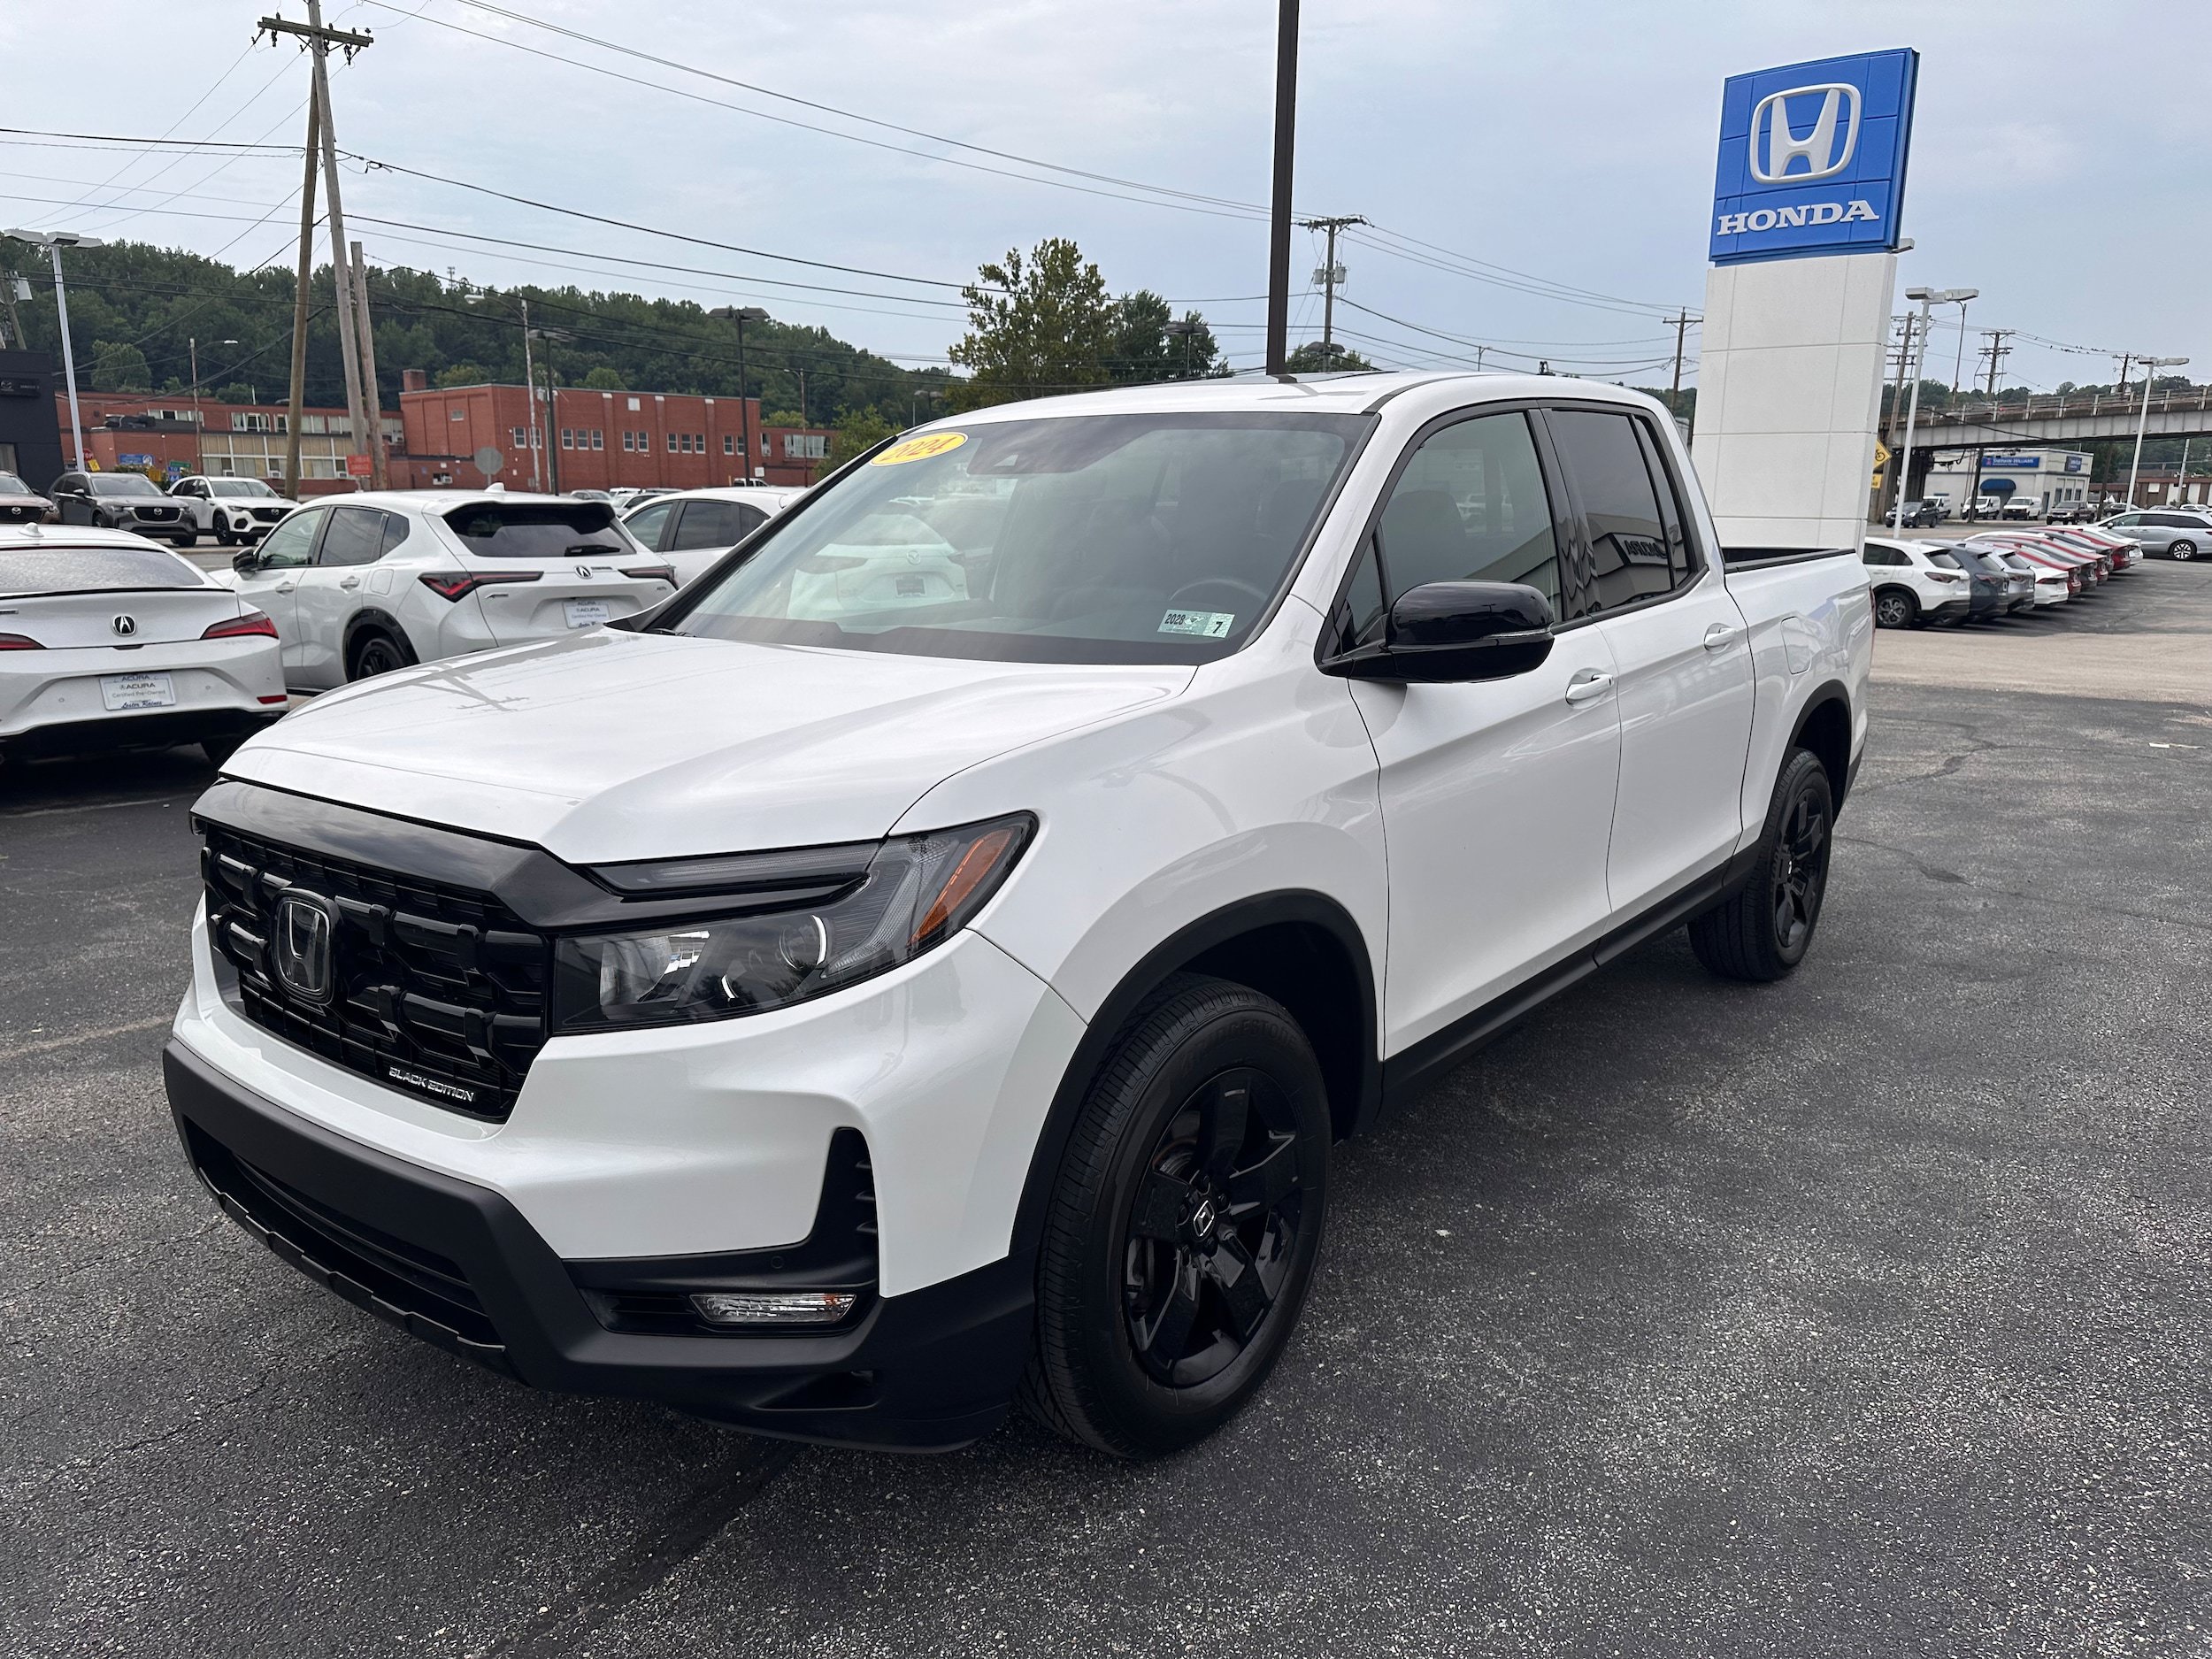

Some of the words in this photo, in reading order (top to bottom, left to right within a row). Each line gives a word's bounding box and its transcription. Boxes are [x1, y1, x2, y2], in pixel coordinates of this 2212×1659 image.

[1717, 199, 1879, 235] HONDA
[879, 436, 958, 462] 2024
[1164, 613, 1186, 626] 2028
[1212, 621, 1224, 634] 7
[389, 1066, 427, 1087] BLACK
[427, 1079, 474, 1102] EDITION
